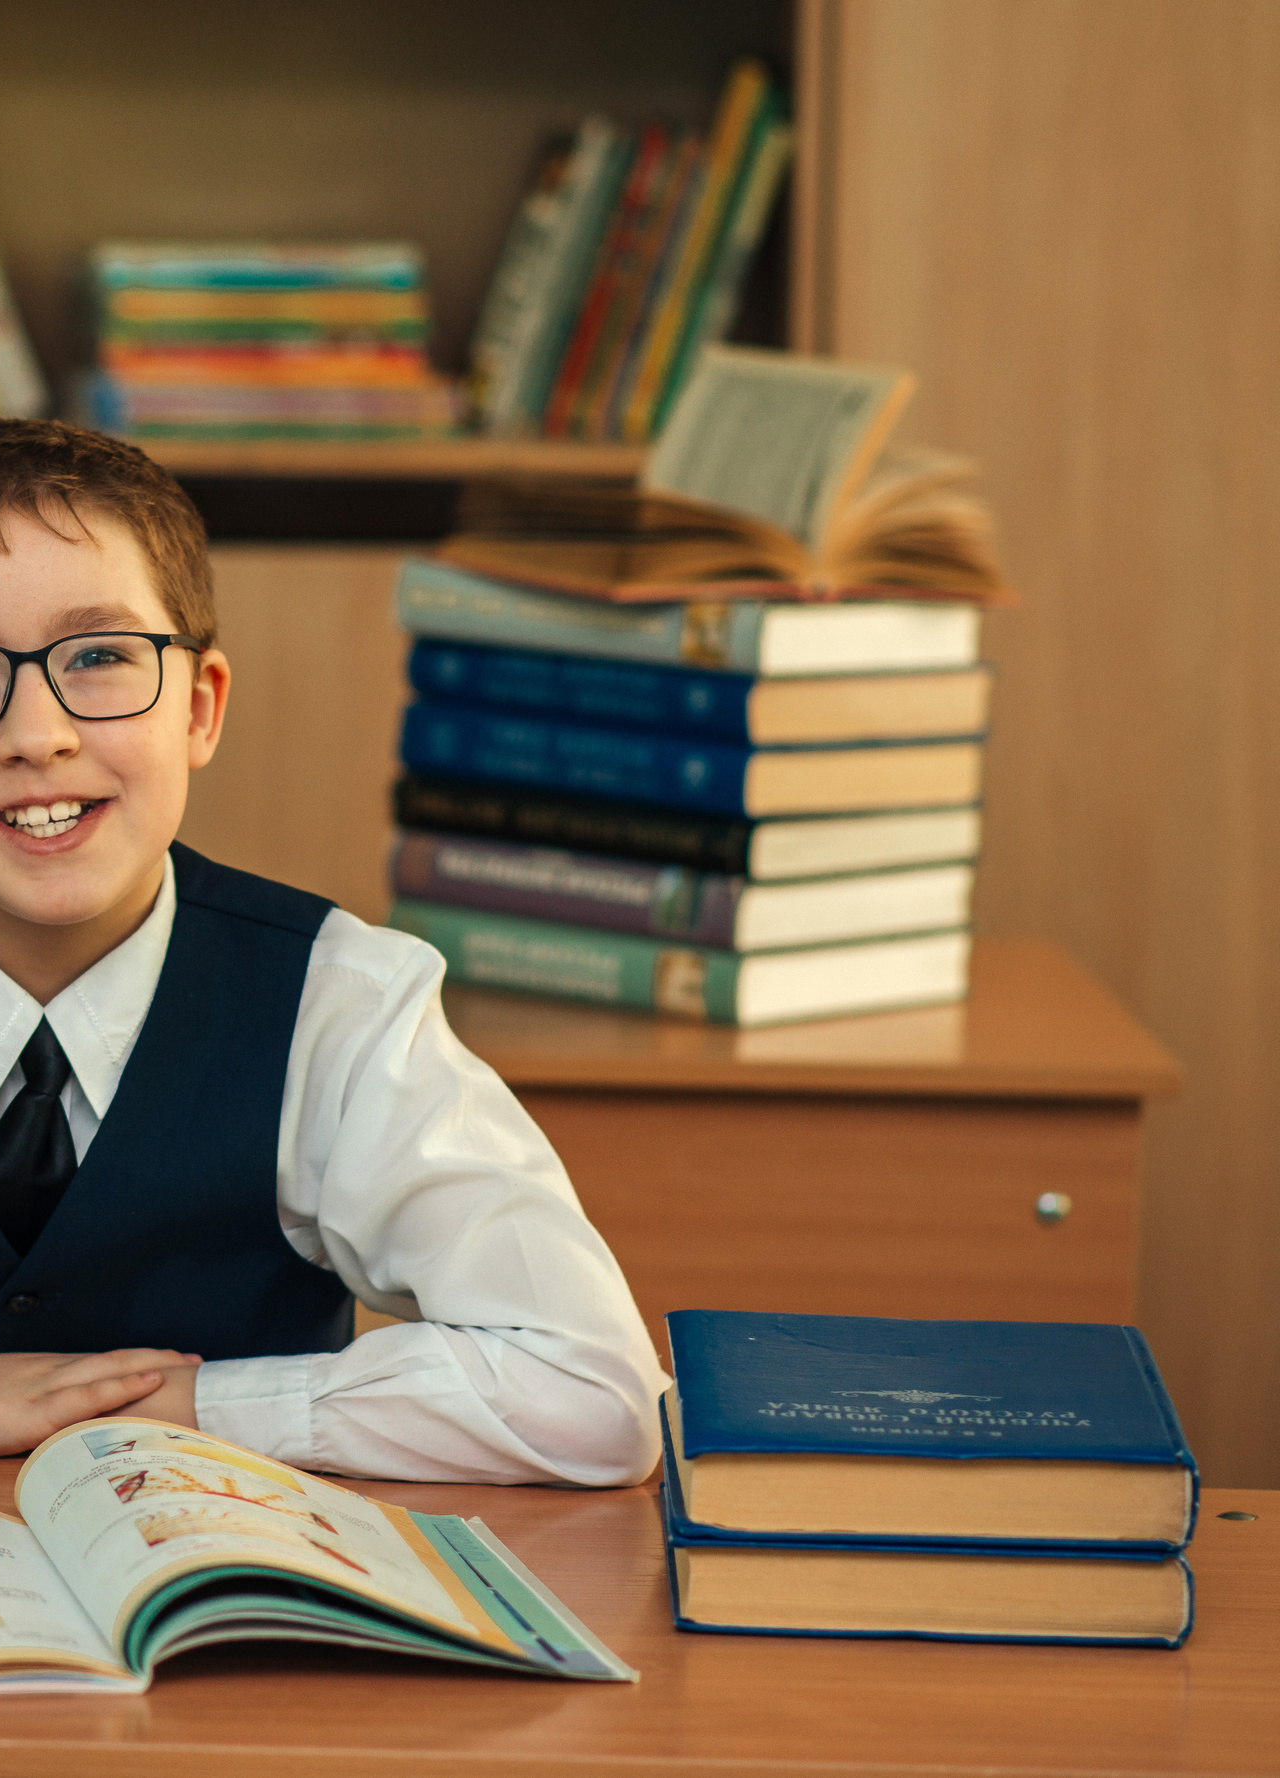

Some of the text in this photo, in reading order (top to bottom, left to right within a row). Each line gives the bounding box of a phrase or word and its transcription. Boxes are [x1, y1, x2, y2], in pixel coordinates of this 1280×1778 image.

[758, 1409, 1093, 1427] УЧЕБНЫЙ СЛОВАРЬ
[766, 1402, 1077, 1419] РУССКОГО ЯЗЫКА
